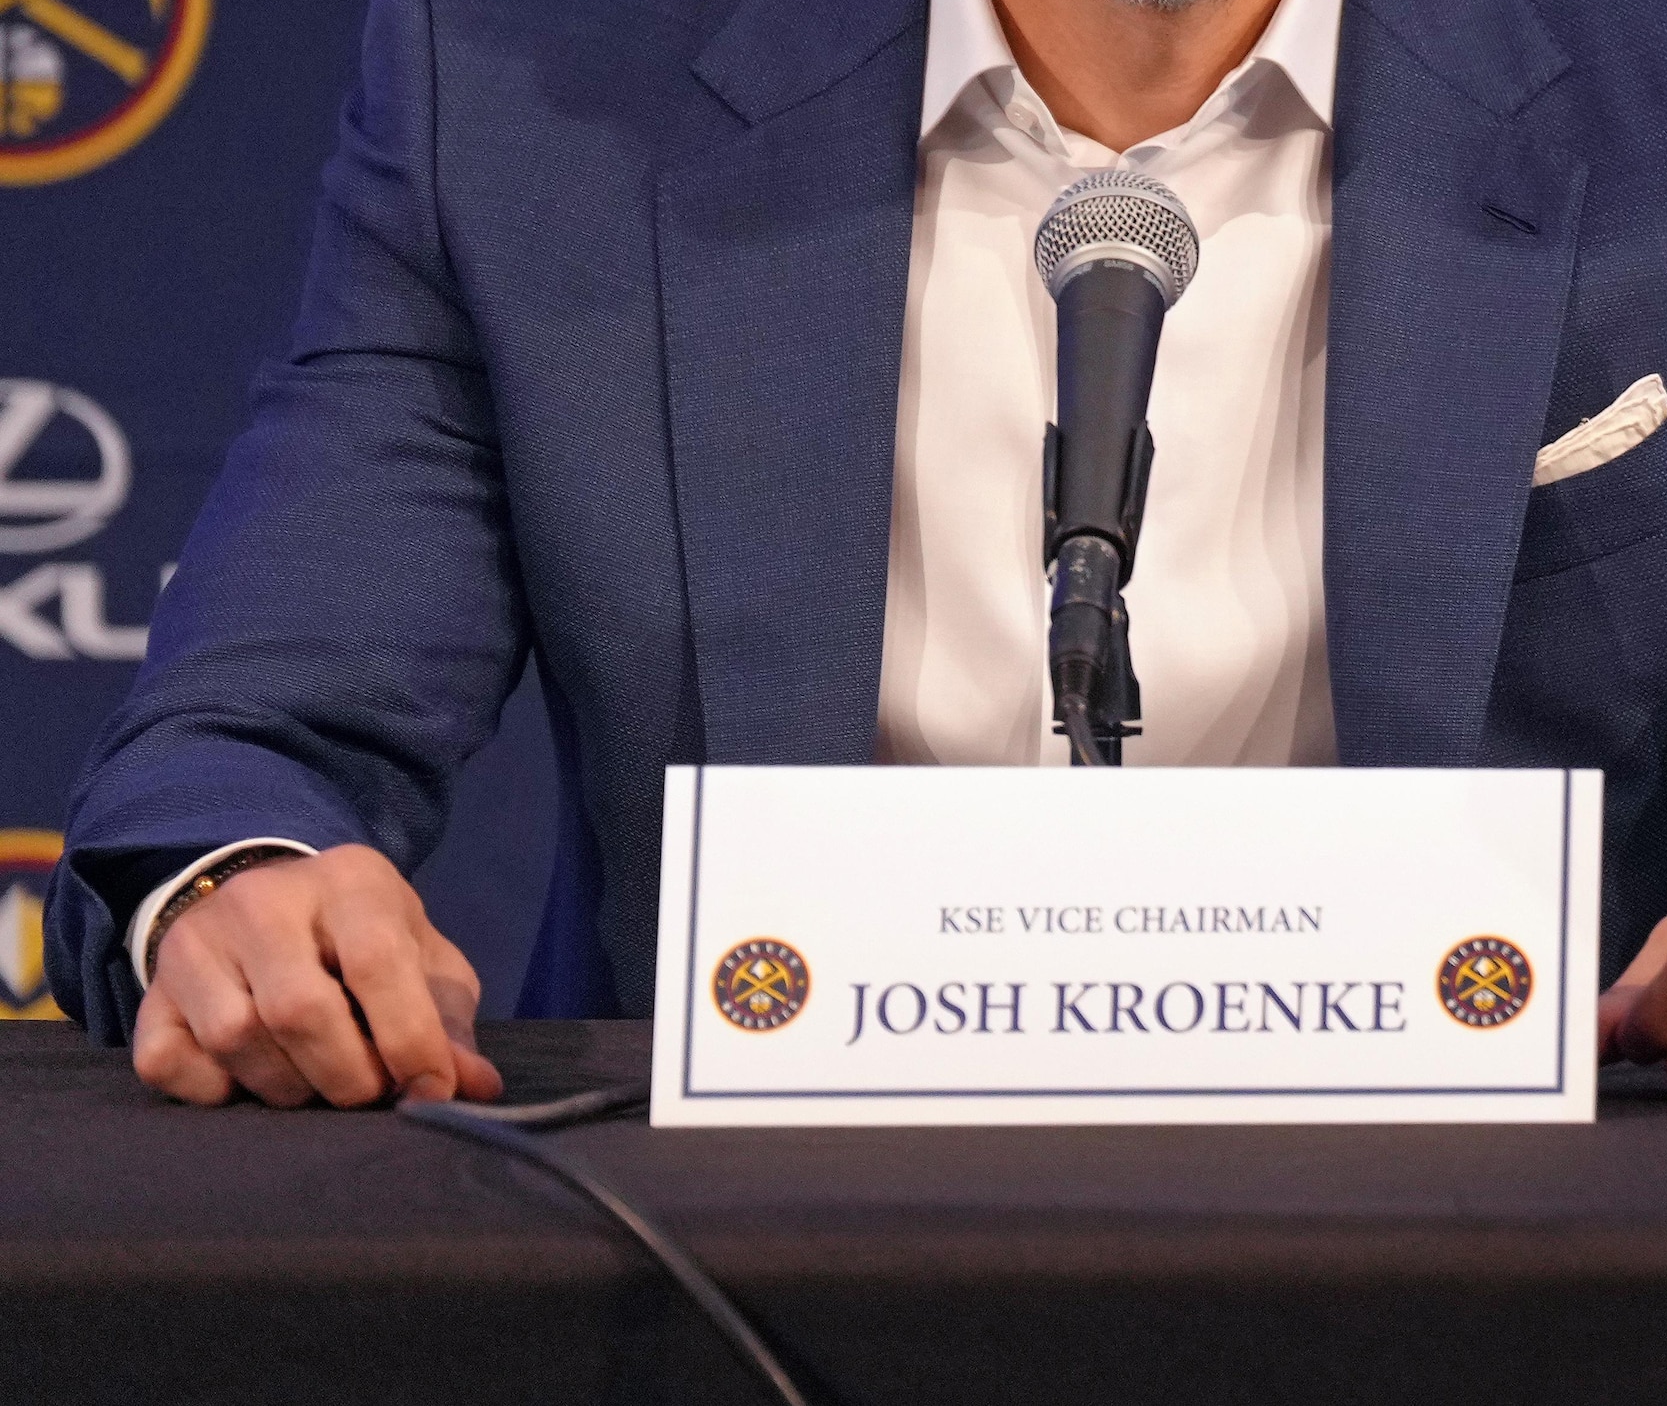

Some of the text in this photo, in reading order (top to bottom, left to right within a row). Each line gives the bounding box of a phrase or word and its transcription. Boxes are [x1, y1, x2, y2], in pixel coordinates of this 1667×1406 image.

[939, 906, 1322, 934] KSE VICE CHAIRMAN
[847, 982, 1409, 1046] JOSH KROENKE
